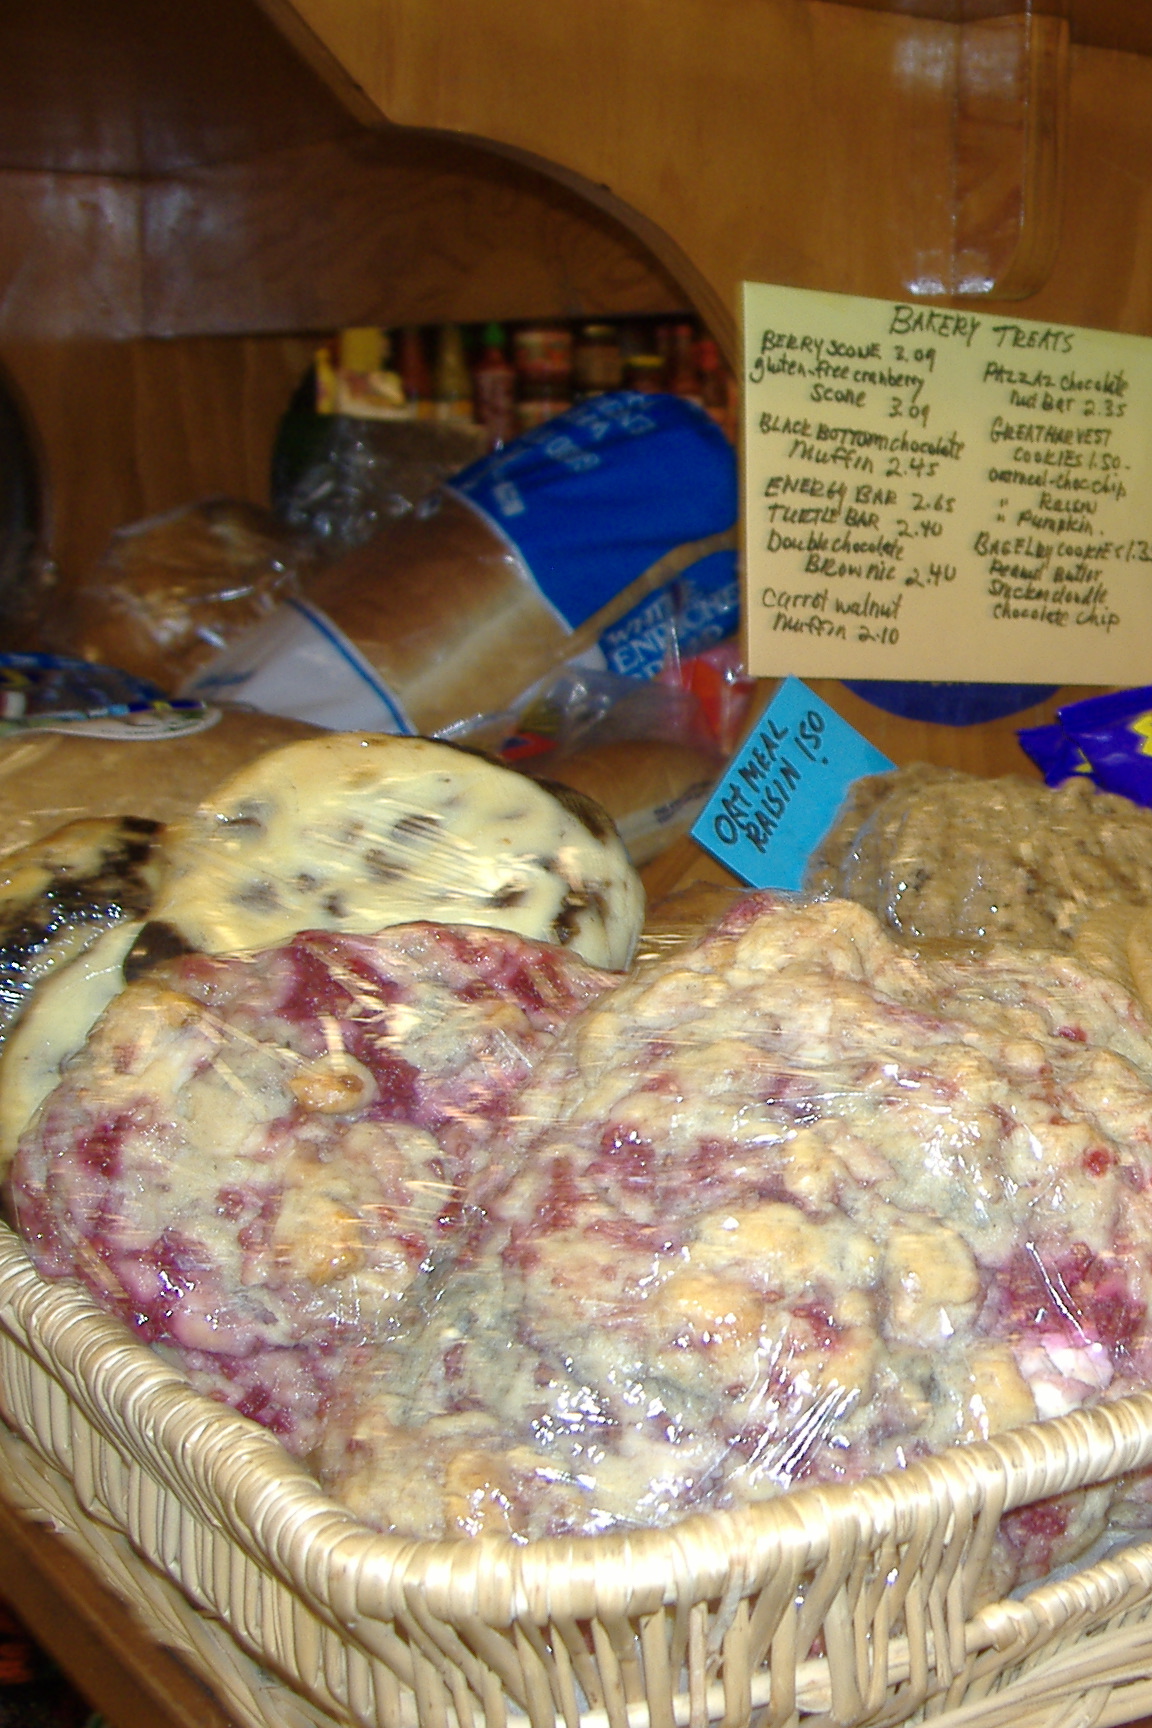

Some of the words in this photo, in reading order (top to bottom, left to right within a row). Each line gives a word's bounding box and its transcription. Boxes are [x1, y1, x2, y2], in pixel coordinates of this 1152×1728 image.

[889, 304, 982, 348] BAKERY
[992, 325, 1075, 353] TREATS
[761, 329, 824, 361] BERRY
[1082, 399, 1128, 418] 2.35
[759, 411, 812, 438] BLACK
[885, 456, 940, 478] 2.45
[855, 484, 898, 506] BAR
[911, 492, 957, 513] 2.65
[844, 505, 881, 532] BAR
[896, 518, 944, 539] 2.40
[905, 562, 957, 588] 2.40
[834, 591, 903, 620] walnut
[857, 624, 900, 645] 2.10
[743, 756, 802, 855] RAISIN
